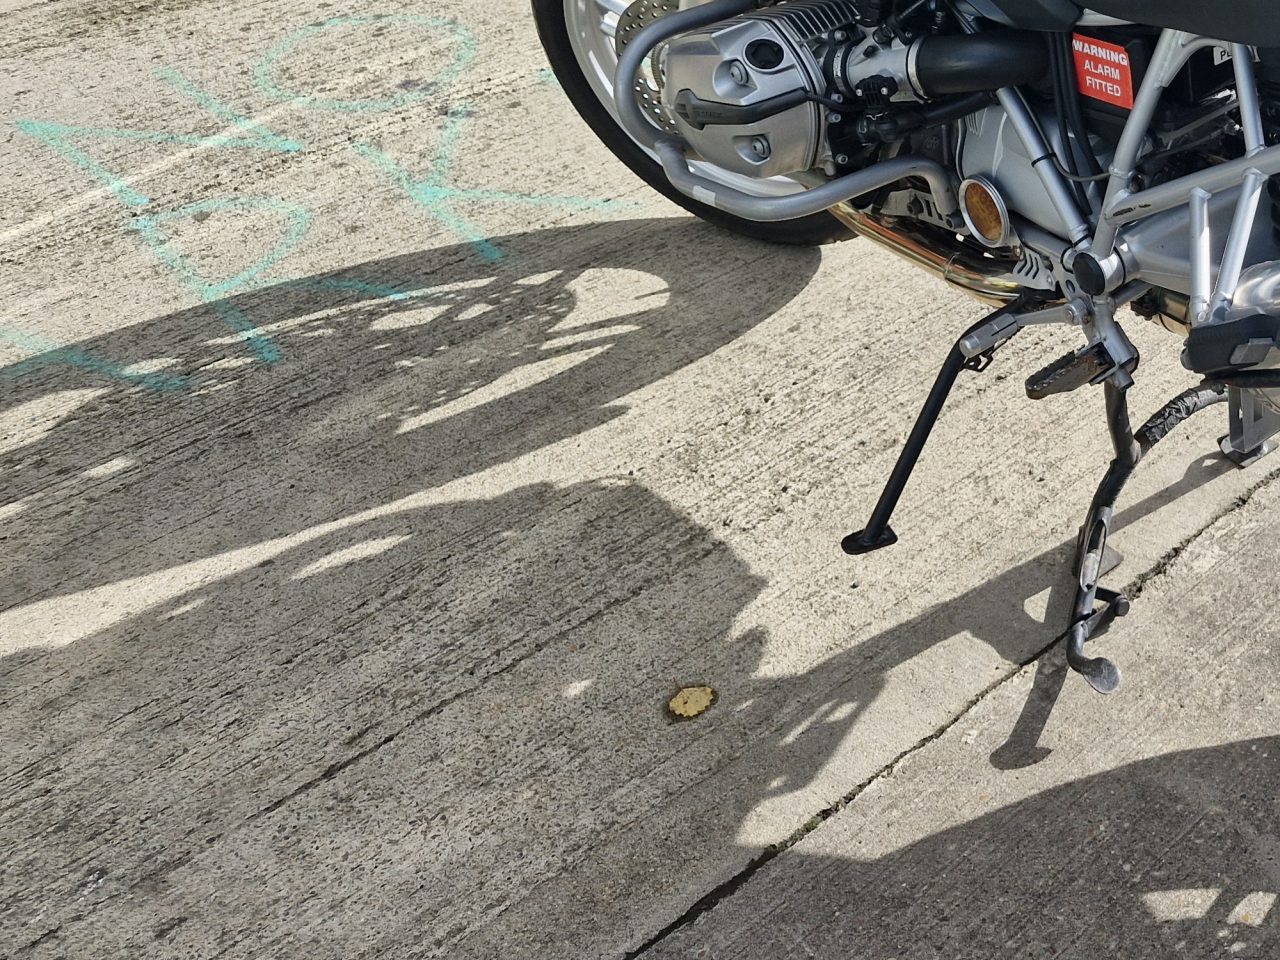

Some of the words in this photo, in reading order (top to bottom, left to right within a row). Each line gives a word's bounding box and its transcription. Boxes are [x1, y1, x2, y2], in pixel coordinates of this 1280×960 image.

[1072, 39, 1128, 67] WARNING
[1084, 59, 1121, 81] ALARM
[1085, 75, 1121, 97] FITTED
